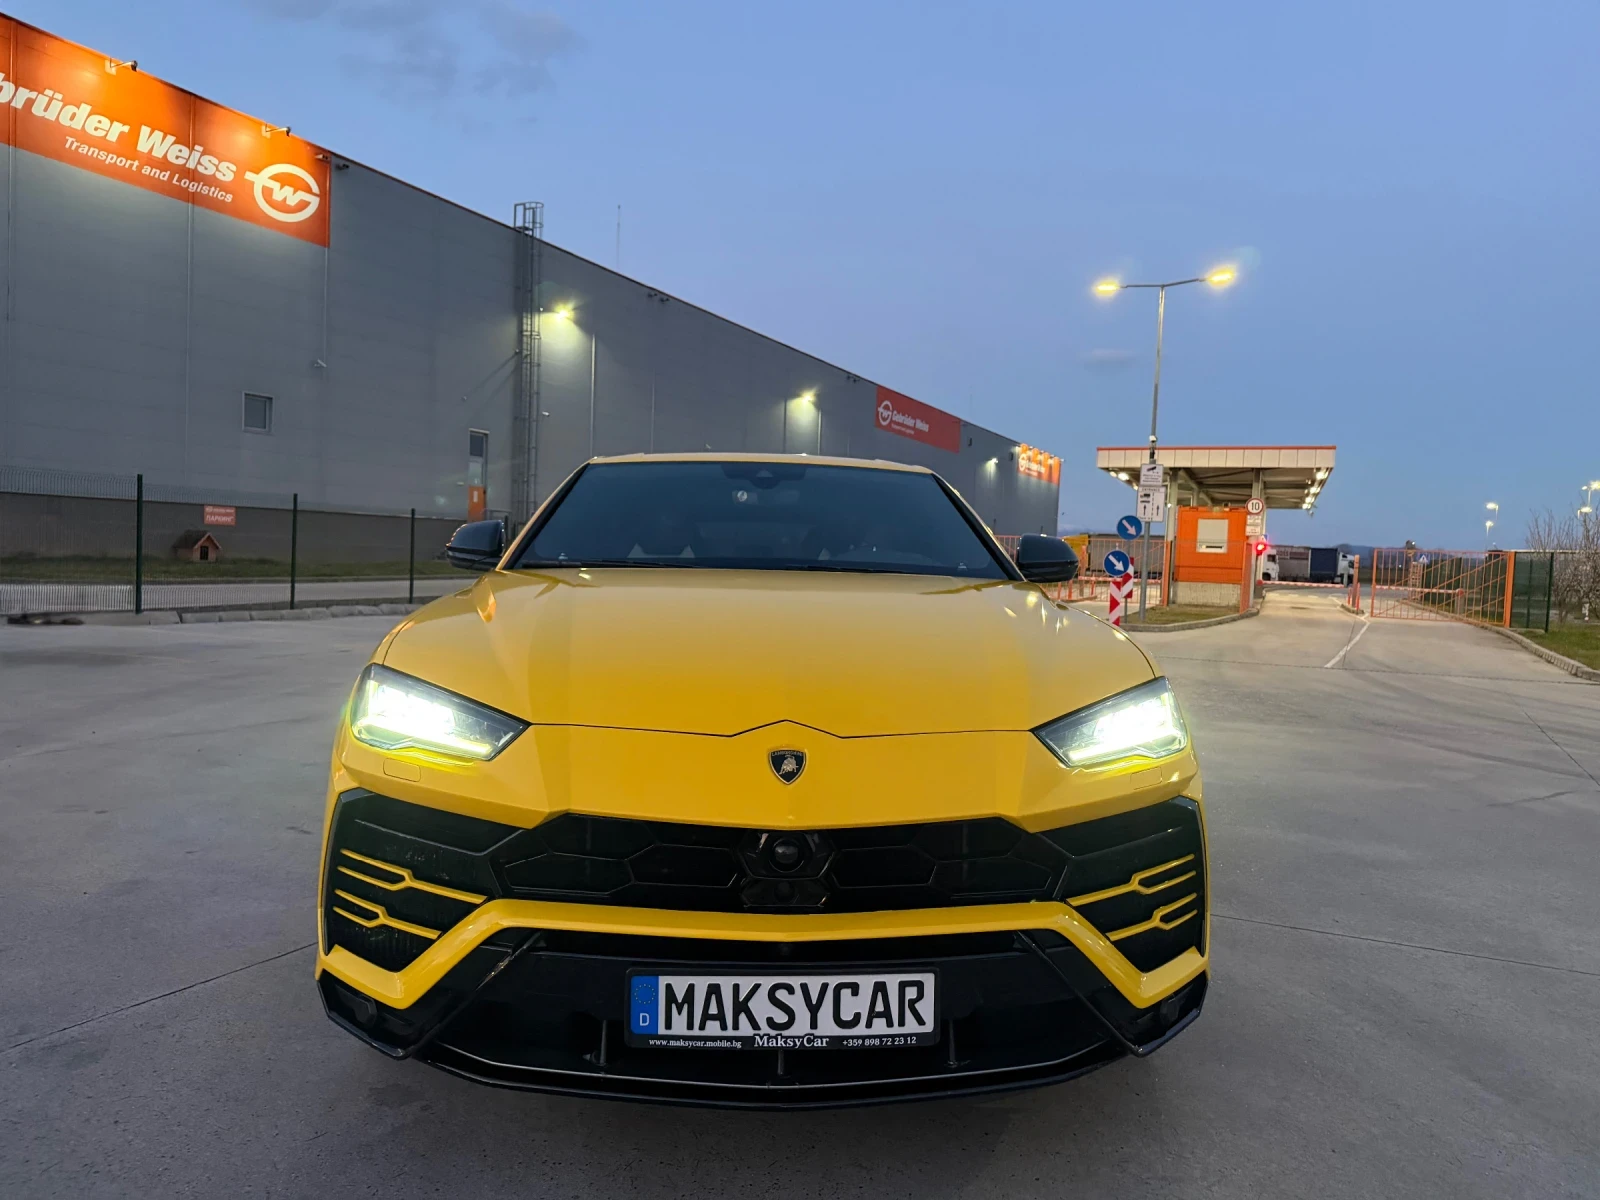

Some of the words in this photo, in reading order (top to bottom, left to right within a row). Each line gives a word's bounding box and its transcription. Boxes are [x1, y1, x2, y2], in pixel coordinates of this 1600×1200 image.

[137, 125, 237, 182] Weiss
[65, 136, 139, 171] Transport
[142, 165, 170, 181] and
[172, 173, 233, 203] Logistics
[1251, 502, 1260, 511] 10
[664, 980, 926, 1031] MAKSYCAR
[639, 1013, 650, 1026] D
[649, 1038, 742, 1048] www.maksycar.mobile.bg
[754, 1035, 829, 1049] MaksyCar
[842, 1039, 862, 1047] +359
[864, 1038, 880, 1046] 898
[882, 1037, 892, 1045] 72
[894, 1037, 904, 1045] 23
[907, 1036, 917, 1044] 12
